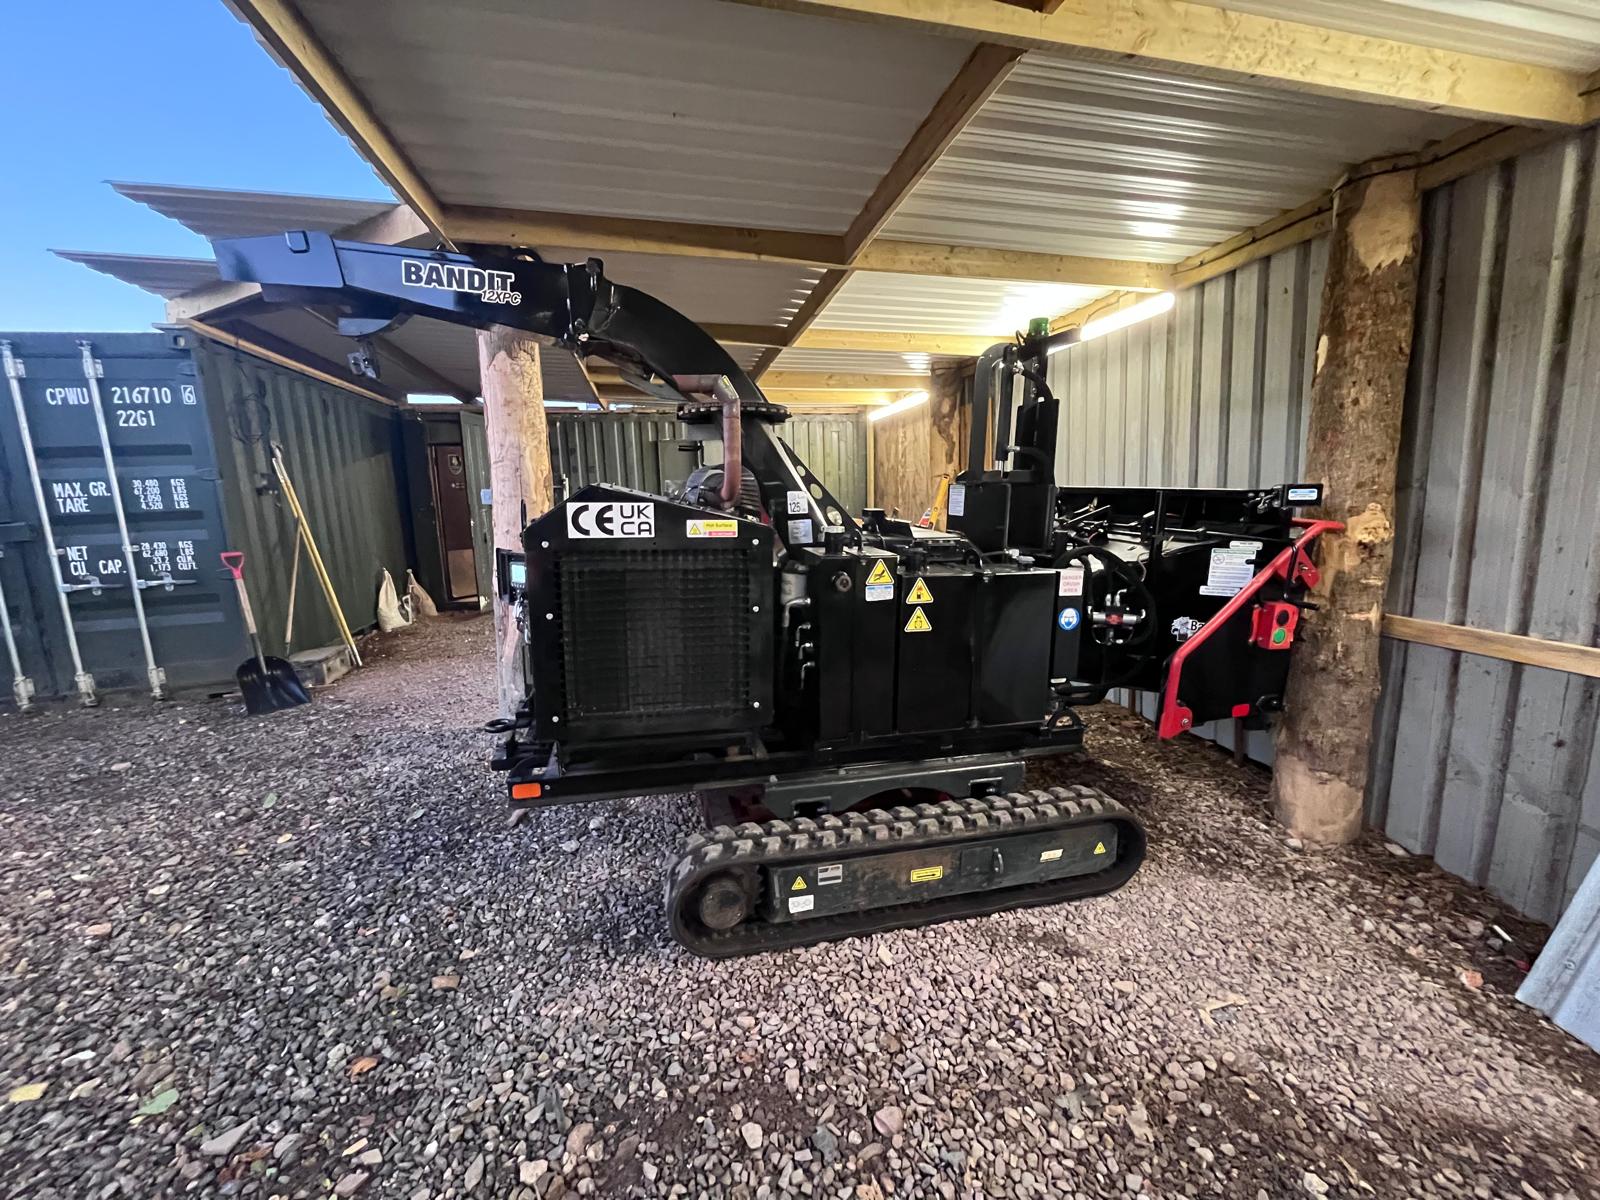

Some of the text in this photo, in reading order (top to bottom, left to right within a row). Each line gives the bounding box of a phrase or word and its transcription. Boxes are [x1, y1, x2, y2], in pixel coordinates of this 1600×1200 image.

[402, 260, 515, 293] BANDIT
[481, 290, 521, 306] 12XPC
[46, 387, 193, 405] CPWU 216710 6
[117, 410, 156, 427] 22G1
[89, 481, 111, 496] GR.
[57, 497, 91, 513] TARE
[620, 504, 652, 519] UK
[789, 501, 800, 513] 125
[571, 504, 614, 536] CE
[620, 521, 652, 535] CA
[66, 546, 88, 561] NET
[98, 559, 127, 574] CAP.
